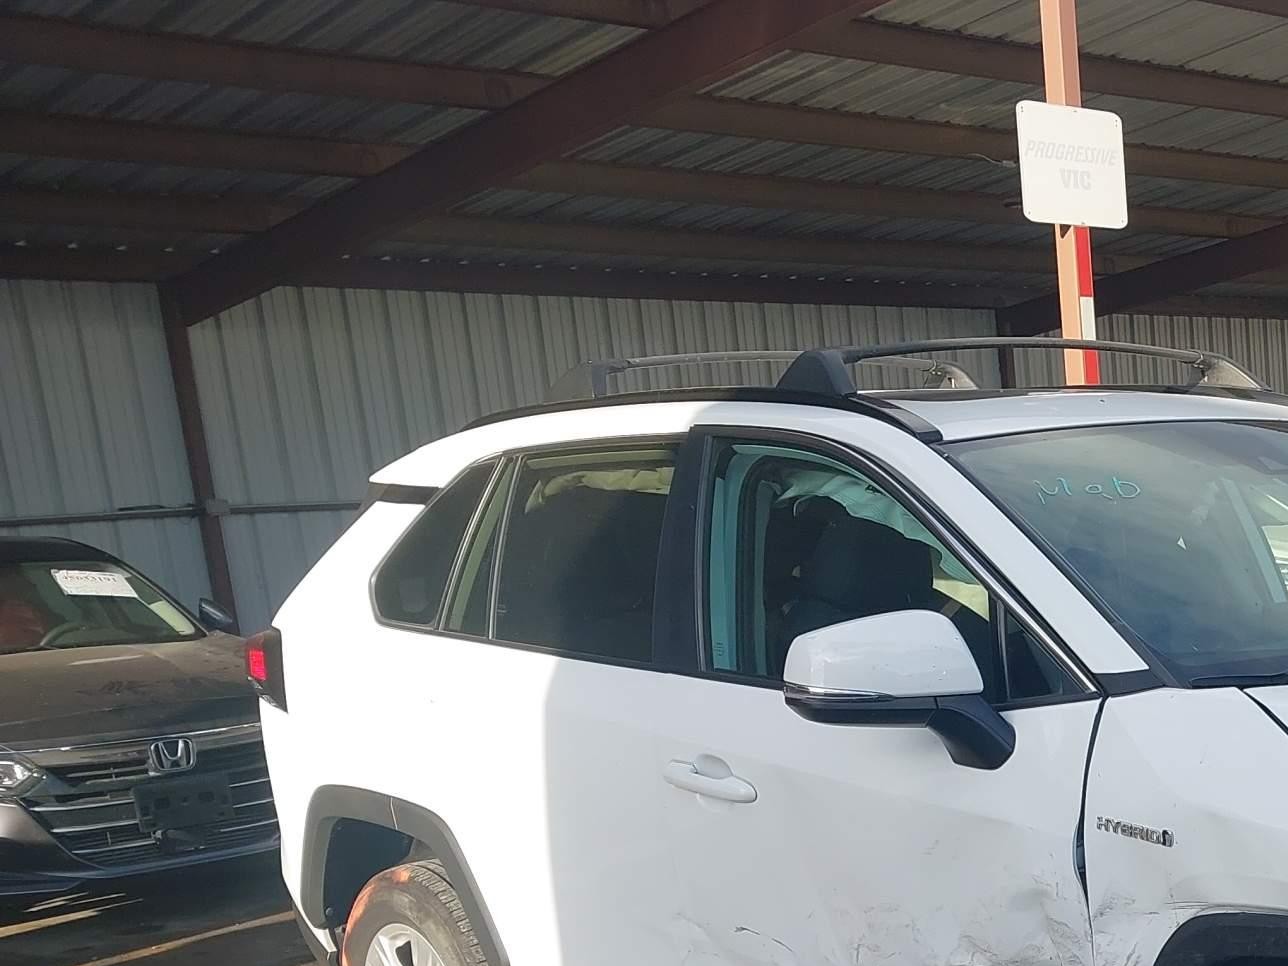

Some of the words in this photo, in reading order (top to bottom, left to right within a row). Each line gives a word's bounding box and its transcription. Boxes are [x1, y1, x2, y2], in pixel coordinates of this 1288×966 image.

[1024, 139, 1118, 166] PROGRESSIVE
[1059, 168, 1092, 190] VIC
[1096, 816, 1161, 845] HYBRID
